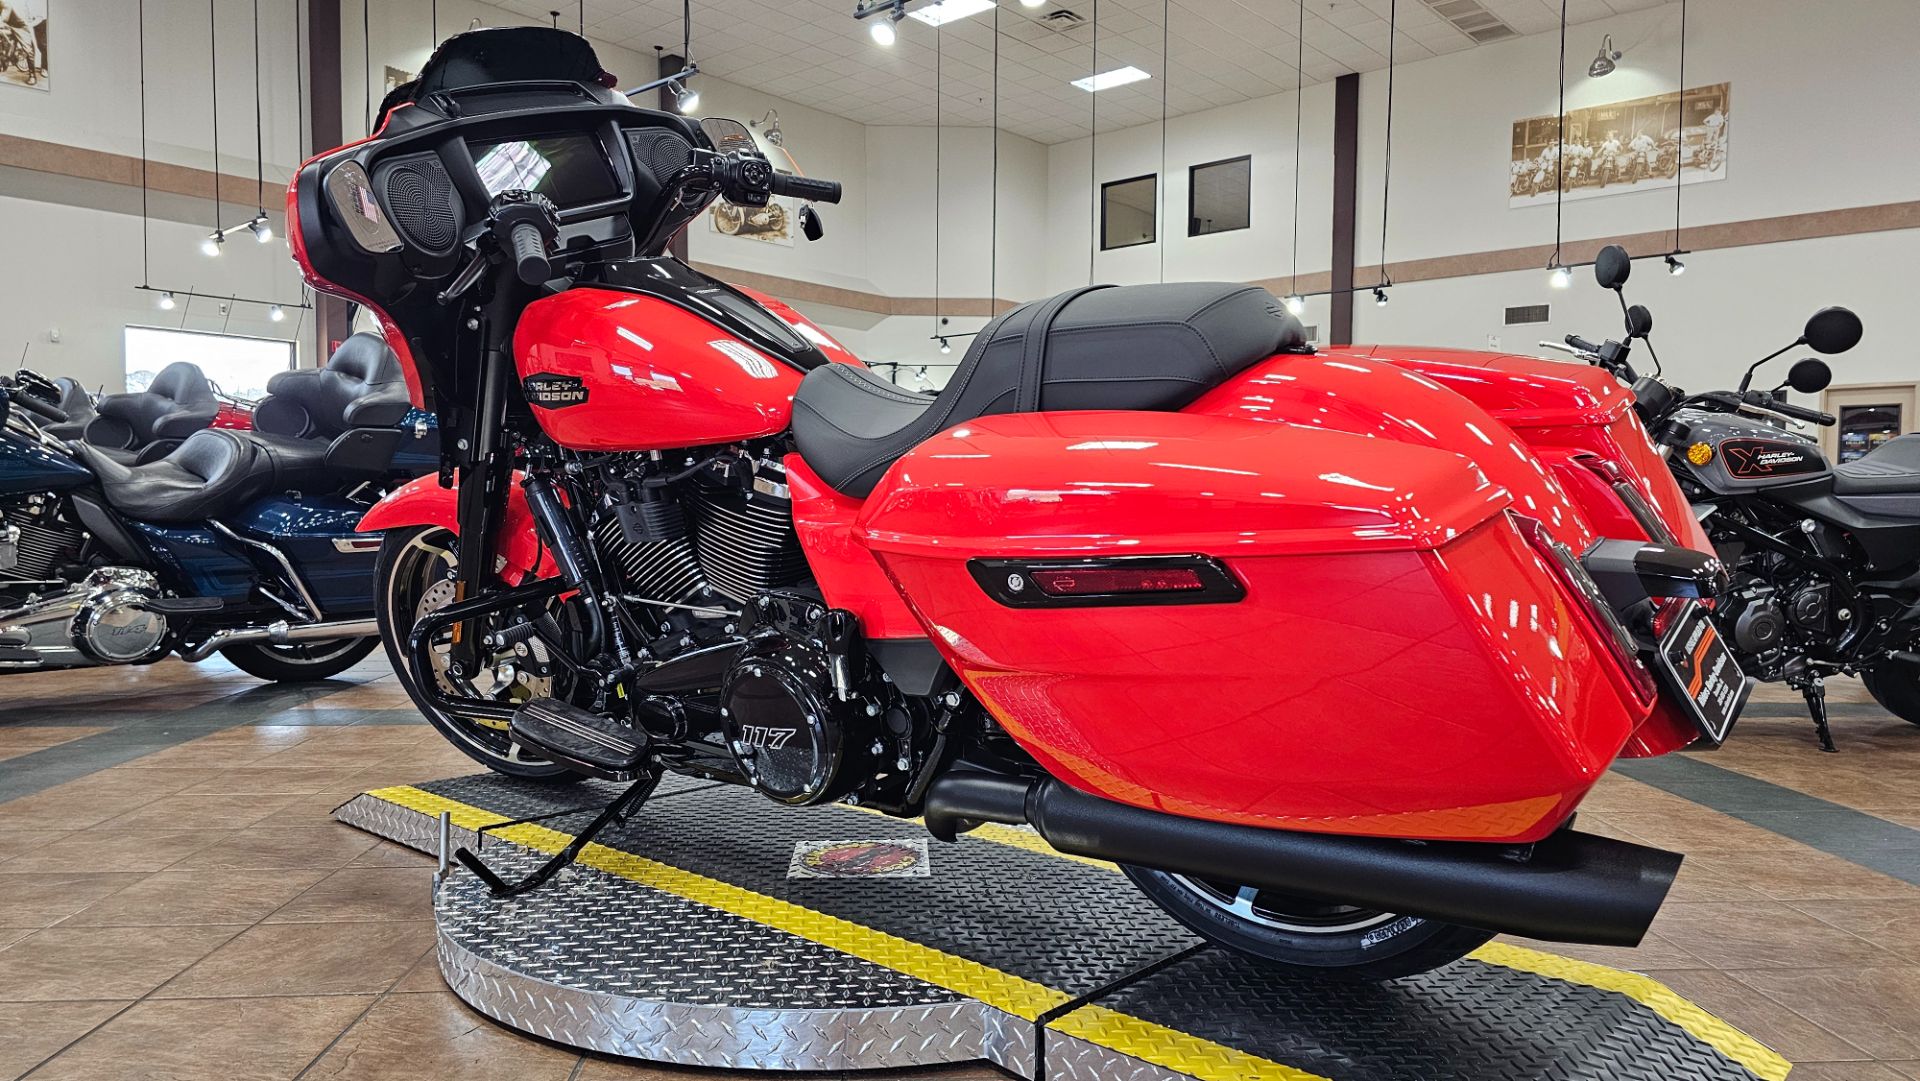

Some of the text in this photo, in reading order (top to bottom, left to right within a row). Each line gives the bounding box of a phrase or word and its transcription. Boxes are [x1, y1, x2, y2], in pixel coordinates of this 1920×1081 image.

[1757, 451, 1795, 460] HARLEY-
[1760, 456, 1804, 465] DAVIDSON
[742, 724, 797, 750] 117
